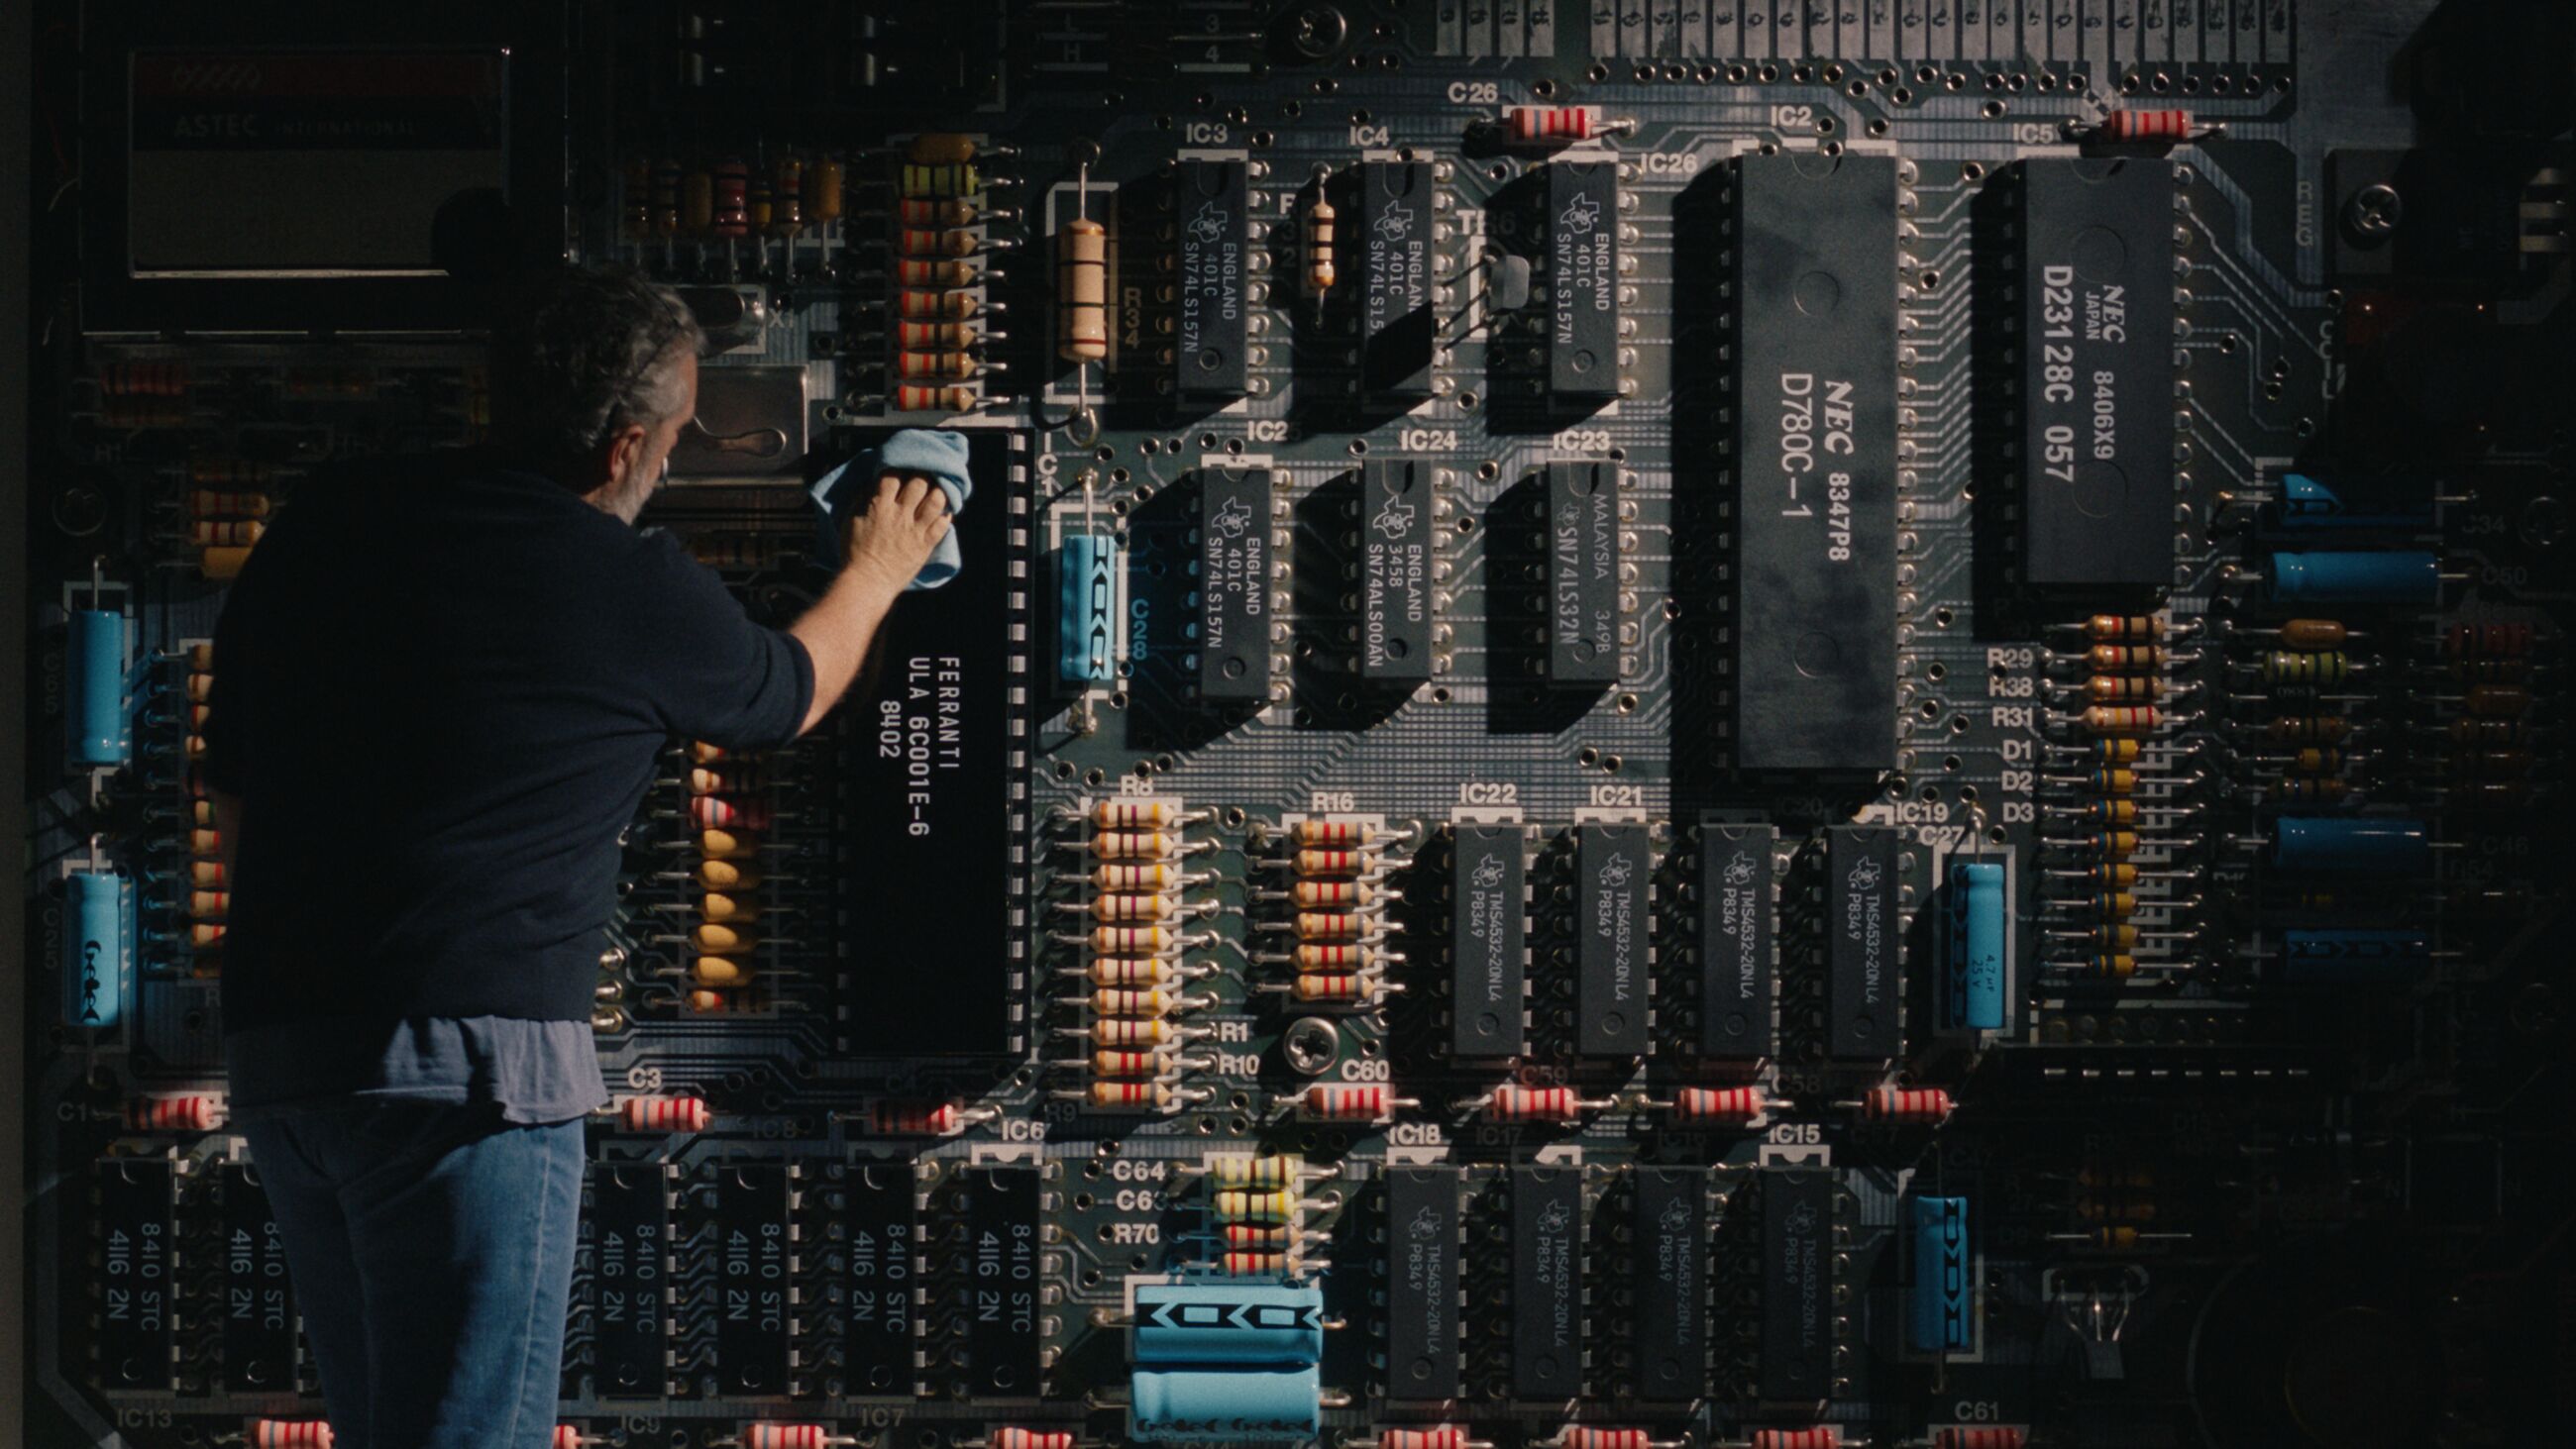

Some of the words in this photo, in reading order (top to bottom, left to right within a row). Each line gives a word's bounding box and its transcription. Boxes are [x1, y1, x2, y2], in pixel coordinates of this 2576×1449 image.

[1206, 13, 1221, 34] 3
[1063, 43, 1081, 62] H
[1204, 45, 1221, 63] 4
[1448, 82, 1499, 103] C26
[173, 113, 260, 138] ASTEC
[1771, 106, 1813, 128] IC2
[1185, 122, 1229, 145] IC3
[1348, 125, 1390, 147] IC4
[2012, 124, 2055, 146] IC5
[1641, 154, 1699, 174] IC26
[1223, 242, 1237, 320] ENGLAND
[1370, 240, 1385, 333] SN74LS15
[1408, 240, 1423, 311] ENGLAN
[1595, 233, 1610, 311] ENGLAND
[1183, 242, 1199, 353] SN74LS157N
[1556, 233, 1571, 345] SN74LS157N
[2085, 291, 2100, 341] JAPAN
[2102, 284, 2126, 344] NEC
[2043, 264, 2074, 403] D23128C
[1824, 378, 1854, 457] NEC
[2092, 370, 2114, 461] 8406X9
[1401, 430, 1457, 452] IC24
[1553, 430, 1610, 452] IC23
[1781, 371, 1813, 518] D780C-1
[2043, 425, 2075, 483] 057
[1828, 472, 1851, 562] 8347P8
[1594, 494, 1611, 580] MALAYSIA
[1245, 537, 1260, 616] ENGLAND
[1388, 544, 1403, 587] 3458
[1208, 537, 1223, 649] SN74LS157N
[1407, 544, 1422, 623] ENGLAND
[1557, 526, 1579, 645] SN74LS32N
[1368, 543, 1384, 668] SN74ALS00AN
[1130, 598, 1149, 660] C28
[1594, 609, 1611, 654] 349B
[1986, 647, 2035, 670] R29
[909, 657, 929, 701] ULA
[1987, 676, 2035, 698] R38
[938, 657, 960, 769] FERRANTI
[1991, 706, 2034, 729] R31
[880, 699, 902, 759] 8402
[2001, 739, 2032, 761] D1
[909, 717, 929, 838] 6C001E-6
[1120, 776, 1154, 794] R8
[1459, 783, 1517, 803] IC22
[2000, 770, 2034, 792] D2
[1311, 792, 1355, 812] R16
[1589, 785, 1643, 805] IC21
[1894, 802, 1950, 823] IC19
[2001, 801, 2035, 823] D3
[1918, 825, 1966, 846] C27
[1470, 890, 1485, 938] P8349
[1598, 889, 1612, 937] P8349
[1722, 887, 1737, 935] P8349
[1848, 893, 1862, 940] P8349
[1220, 1022, 1247, 1042] R1
[628, 1068, 662, 1088] C3
[1219, 1055, 1259, 1076] R10
[1342, 1061, 1389, 1083] C60
[1520, 1065, 1568, 1087] C59
[1771, 1073, 1821, 1094] C58
[56, 1101, 86, 1122] C1
[1002, 1120, 1046, 1141] IC6
[1388, 1122, 1443, 1144] IC18
[1769, 1122, 1822, 1145] IC15
[1113, 1161, 1165, 1182] C64
[1114, 1224, 1159, 1245] R70
[1409, 1243, 1424, 1292] P8349
[1537, 1236, 1552, 1285] P8349
[1659, 1234, 1672, 1282] P8349
[1784, 1236, 1798, 1285] P8349
[107, 1289, 129, 1319] 2N
[141, 1291, 160, 1331] STC
[231, 1288, 252, 1319] 2N
[264, 1290, 283, 1330] STC
[602, 1291, 624, 1321] 2N
[635, 1293, 656, 1333] STC
[727, 1289, 748, 1321] 2N
[760, 1292, 781, 1332] STC
[853, 1290, 874, 1321] 2N
[886, 1293, 906, 1333] STC
[978, 1290, 999, 1322] 2N
[1011, 1293, 1030, 1333] STC
[117, 1408, 172, 1429] IC13
[861, 1407, 906, 1428] IC7
[1955, 1400, 1999, 1422] C61
